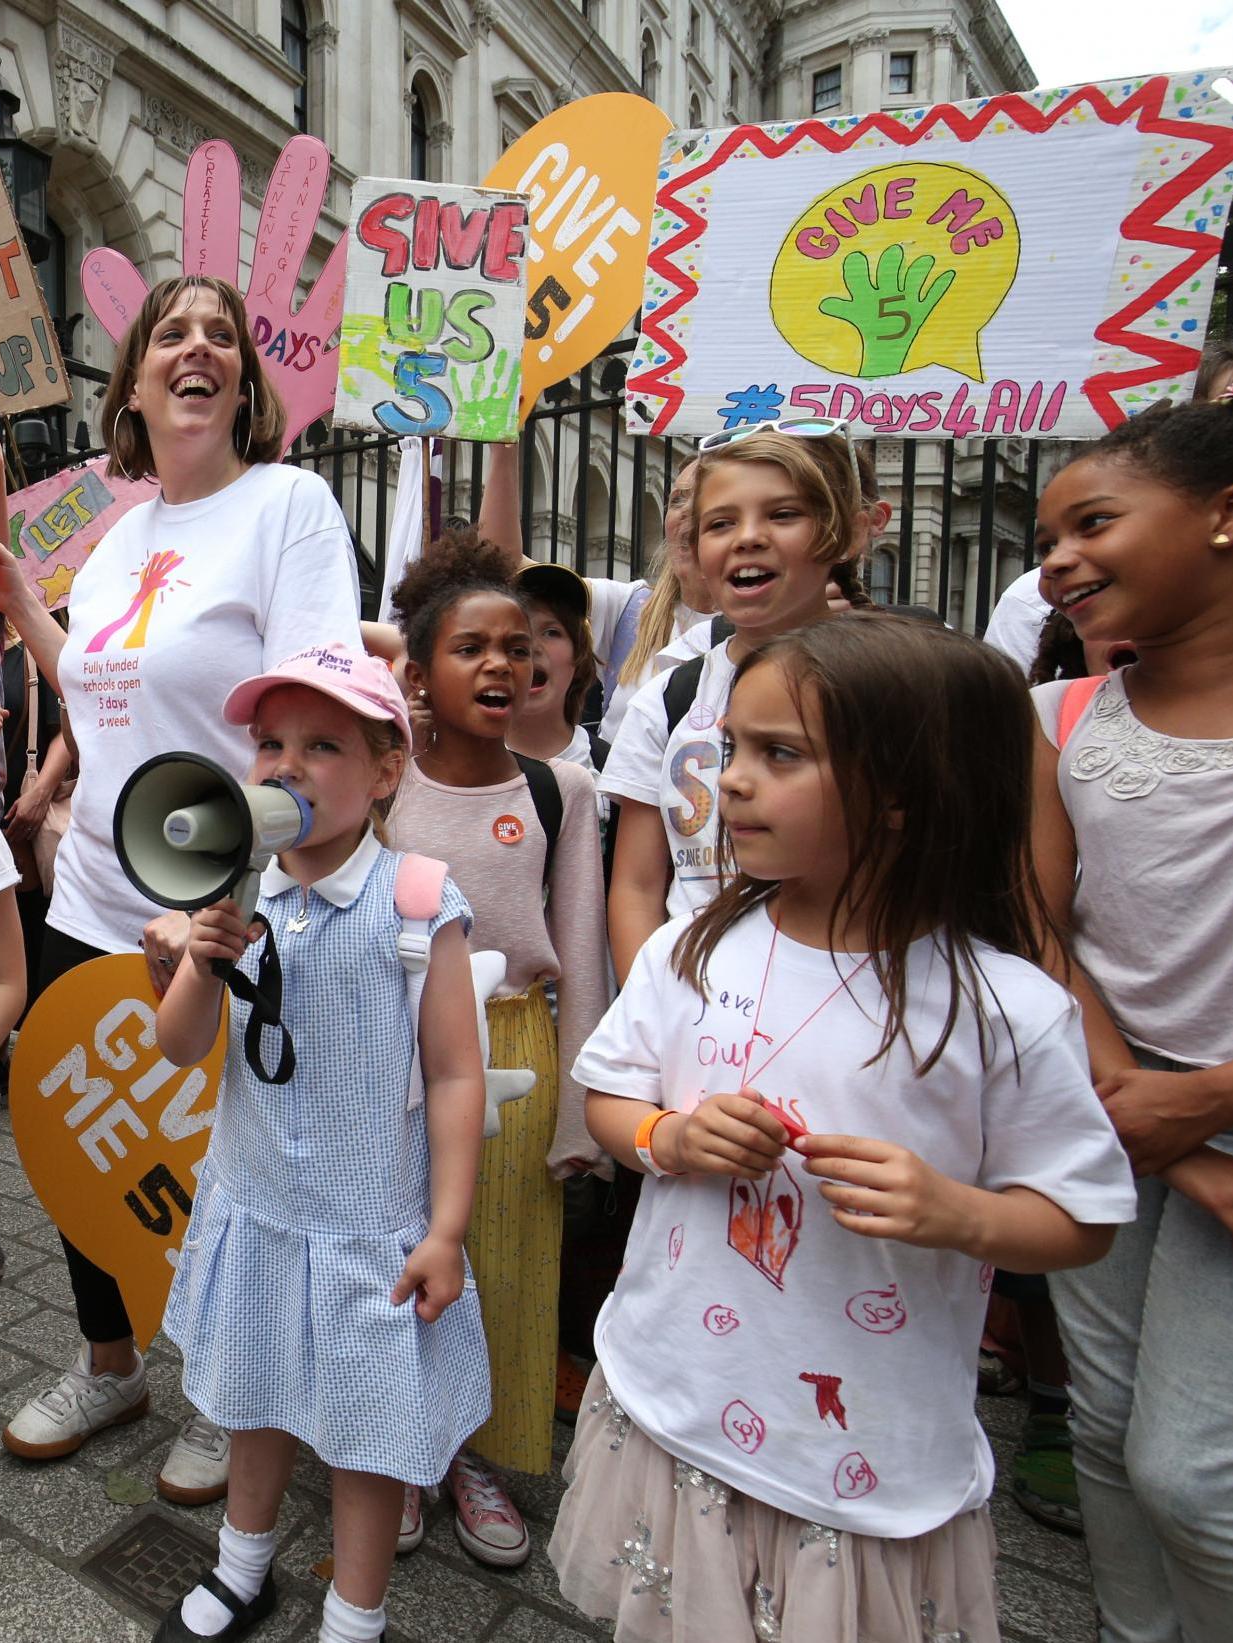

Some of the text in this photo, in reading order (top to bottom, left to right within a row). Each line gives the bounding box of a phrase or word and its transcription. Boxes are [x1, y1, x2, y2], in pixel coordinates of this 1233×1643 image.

[200, 145, 218, 241] CREATIVE
[516, 142, 641, 287] GIVE
[795, 177, 1004, 260] GIVE ME
[355, 192, 527, 283] GIVE
[252, 315, 321, 372] DAYS
[384, 282, 496, 364] US
[876, 294, 913, 342] 5
[371, 350, 450, 437] 5
[30, 485, 94, 552] LET
[83, 657, 139, 676] Fully funded
[83, 678, 141, 693] schools open
[99, 696, 128, 711] 5 days
[99, 713, 131, 727] a week
[498, 822, 517, 830] GIVE
[675, 847, 701, 868] SAVE
[95, 998, 215, 1150] GIV
[38, 1044, 150, 1174] ME
